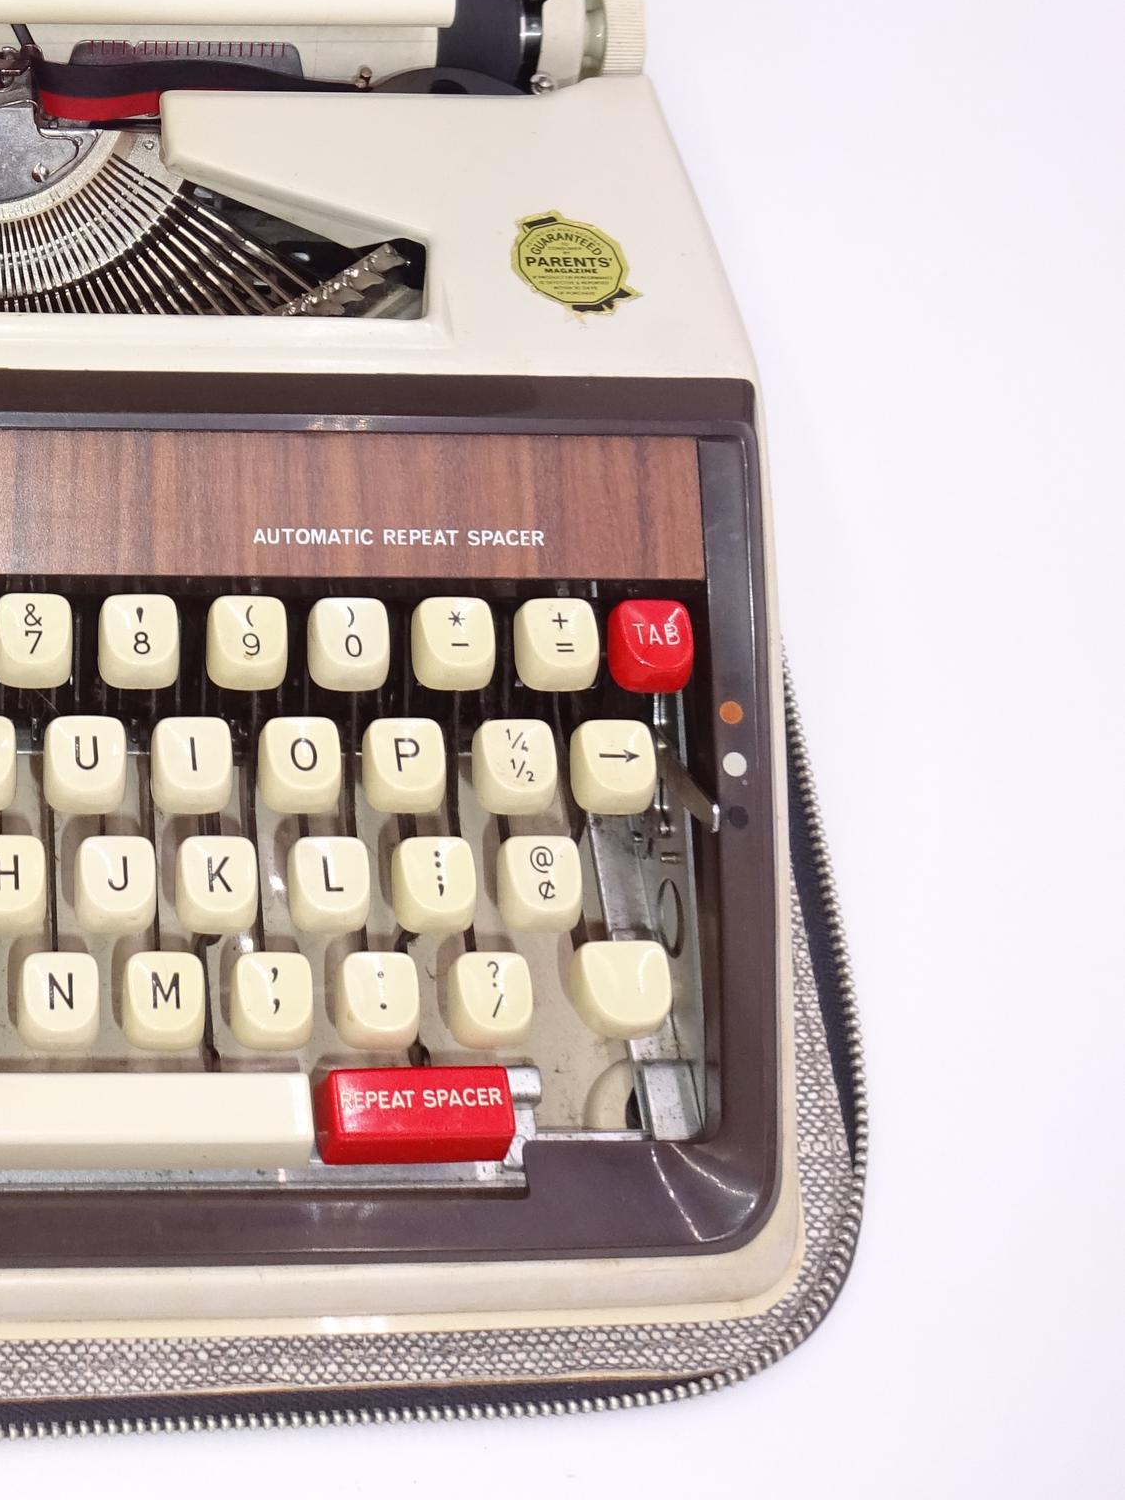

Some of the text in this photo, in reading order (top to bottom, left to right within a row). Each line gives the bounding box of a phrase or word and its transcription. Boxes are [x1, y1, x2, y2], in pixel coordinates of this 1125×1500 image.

[530, 232, 603, 256] GUARANTEED
[253, 528, 545, 546] AUTOMATIC REPEAT SPACER
[23, 602, 43, 627] &
[551, 611, 569, 630] +
[24, 629, 43, 655] 7
[133, 631, 151, 655] 8
[242, 632, 261, 657] 9
[344, 633, 363, 658] 0
[631, 623, 681, 646] TAB
[74, 735, 99, 771] U
[290, 737, 318, 772] O
[393, 737, 421, 773] P
[529, 845, 554, 874] @
[107, 855, 129, 892] J
[207, 856, 233, 893] K
[321, 856, 345, 893] L
[486, 960, 500, 988] ?
[48, 972, 74, 1011] N
[151, 971, 181, 1010] M
[340, 1087, 504, 1110] REPEAT SPACER
